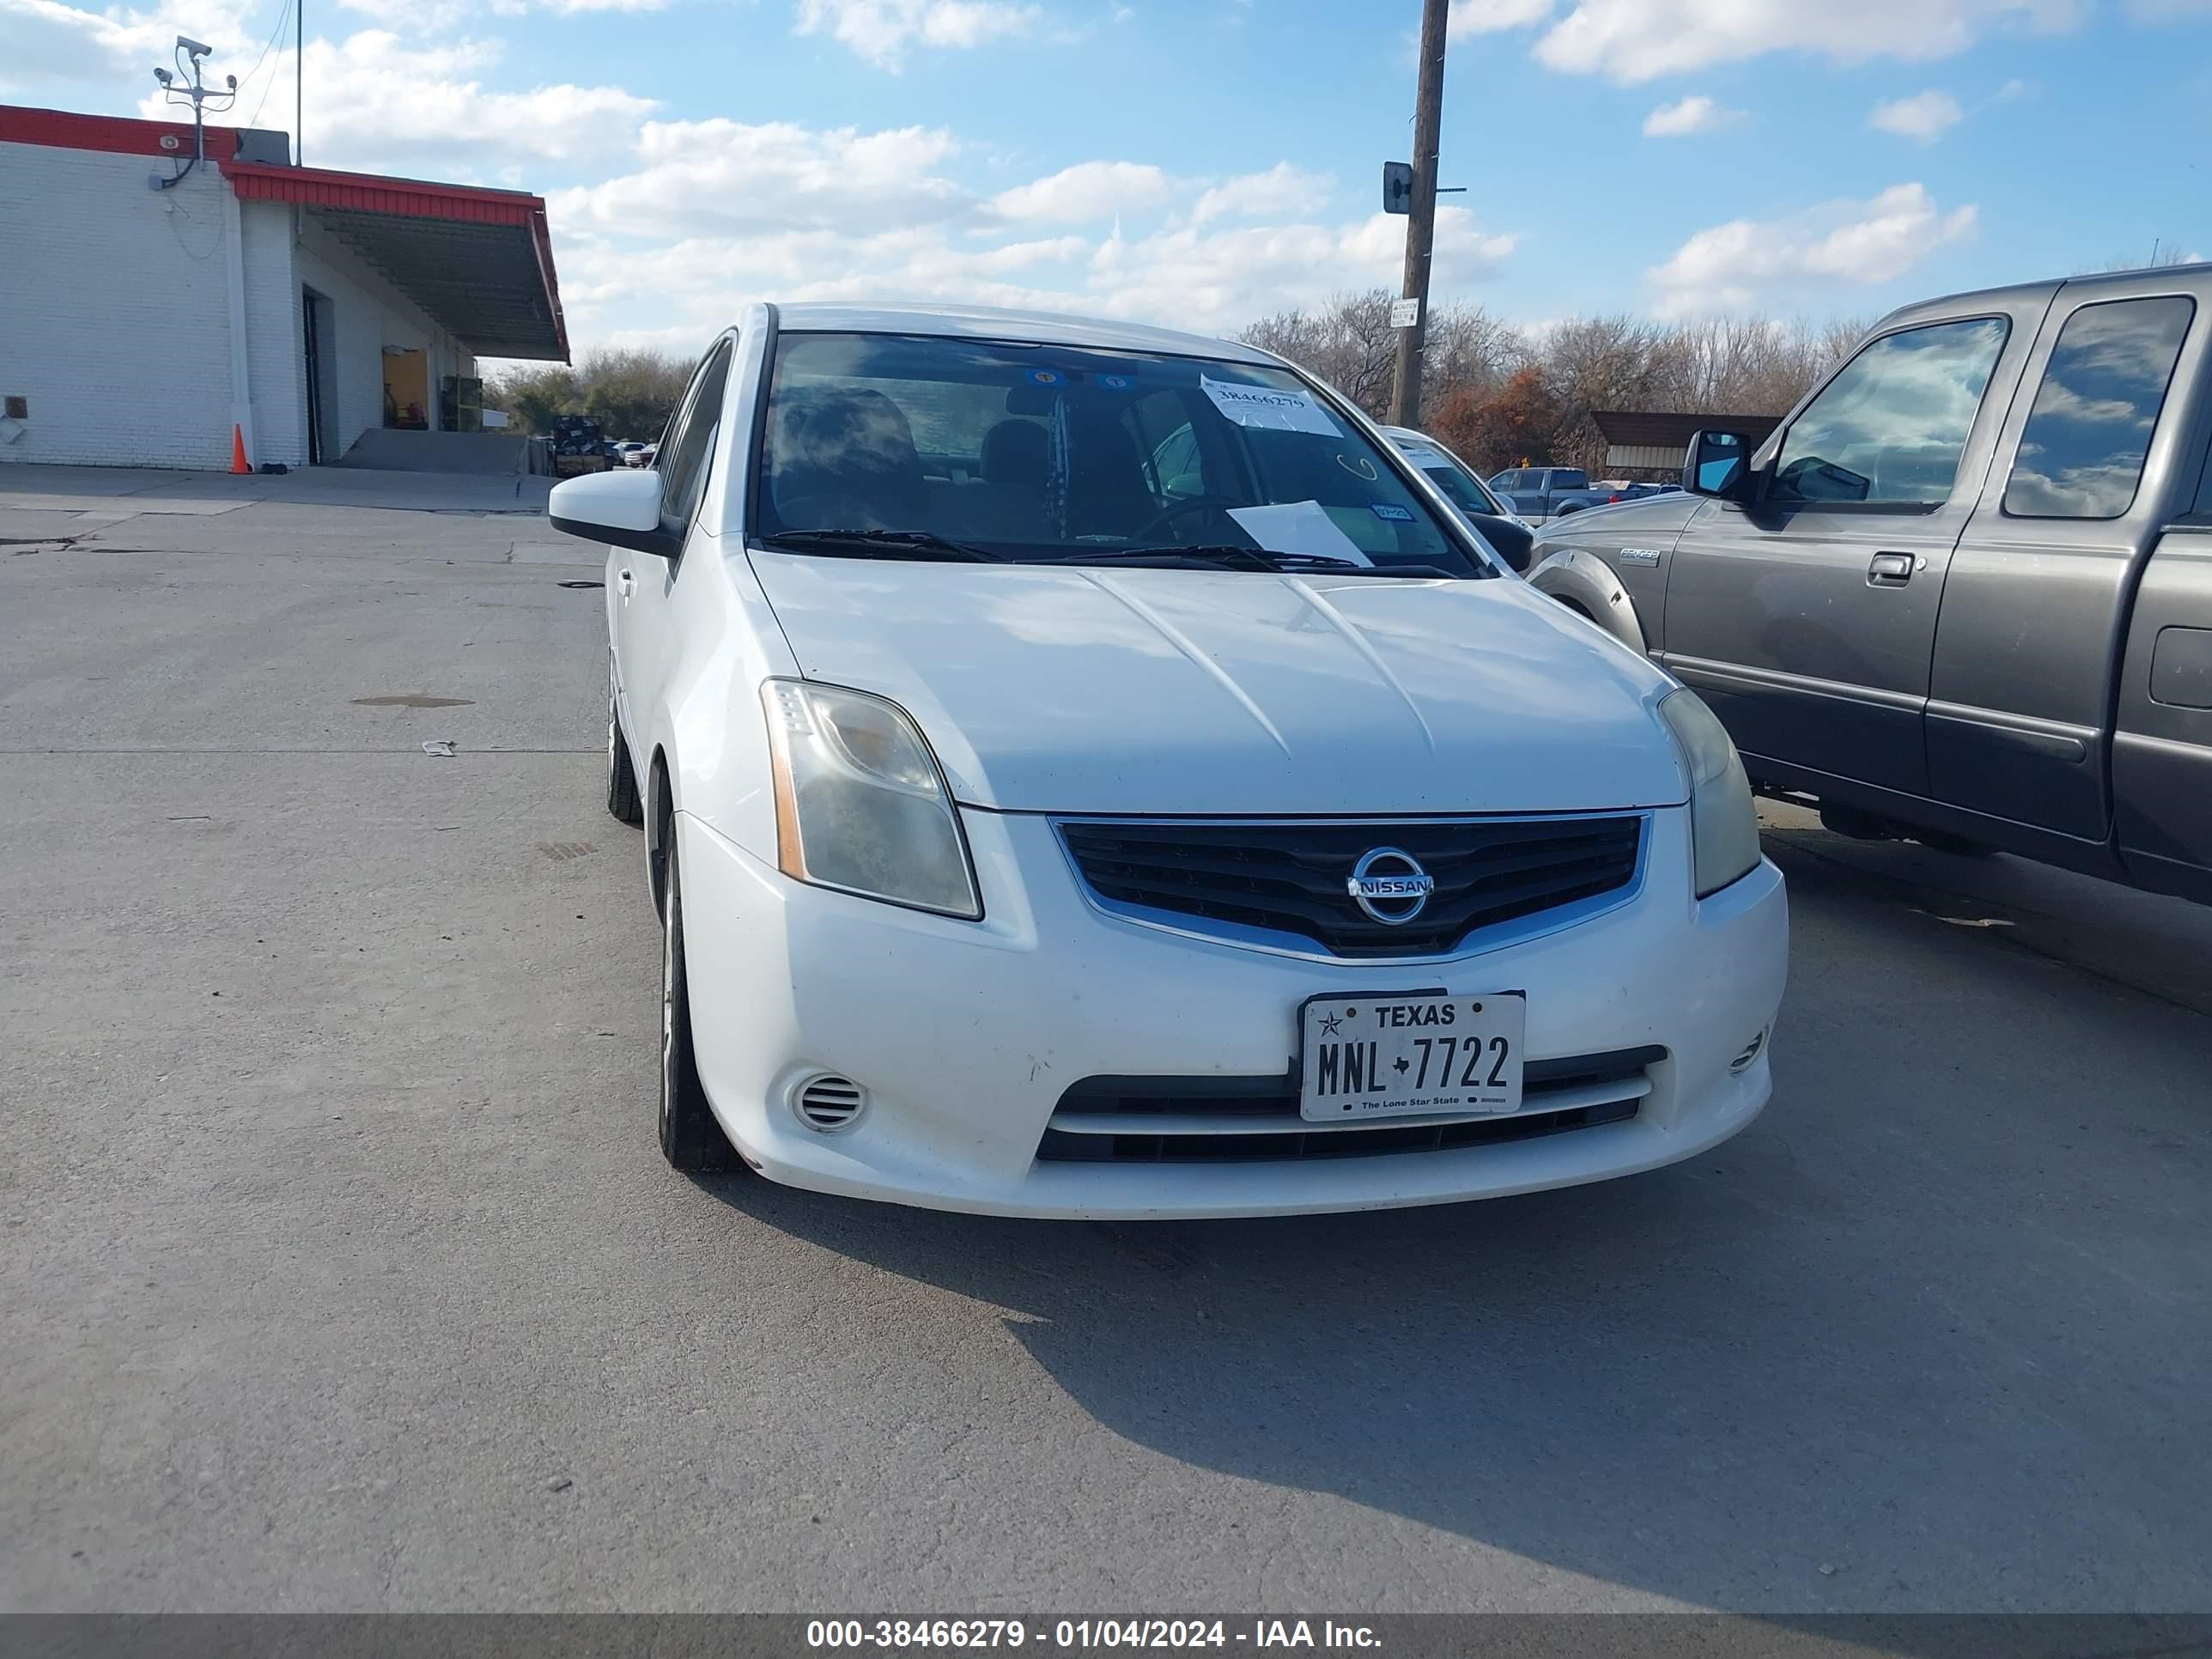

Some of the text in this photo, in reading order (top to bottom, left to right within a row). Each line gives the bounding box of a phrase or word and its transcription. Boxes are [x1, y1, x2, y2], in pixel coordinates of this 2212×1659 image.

[1217, 391, 1305, 408] 38466279
[1360, 880, 1427, 893] NISSAN
[1375, 1004, 1455, 1028] TEXAS
[1317, 1036, 1509, 1096] MNL 7722
[1382, 1099, 1407, 1108] Lone
